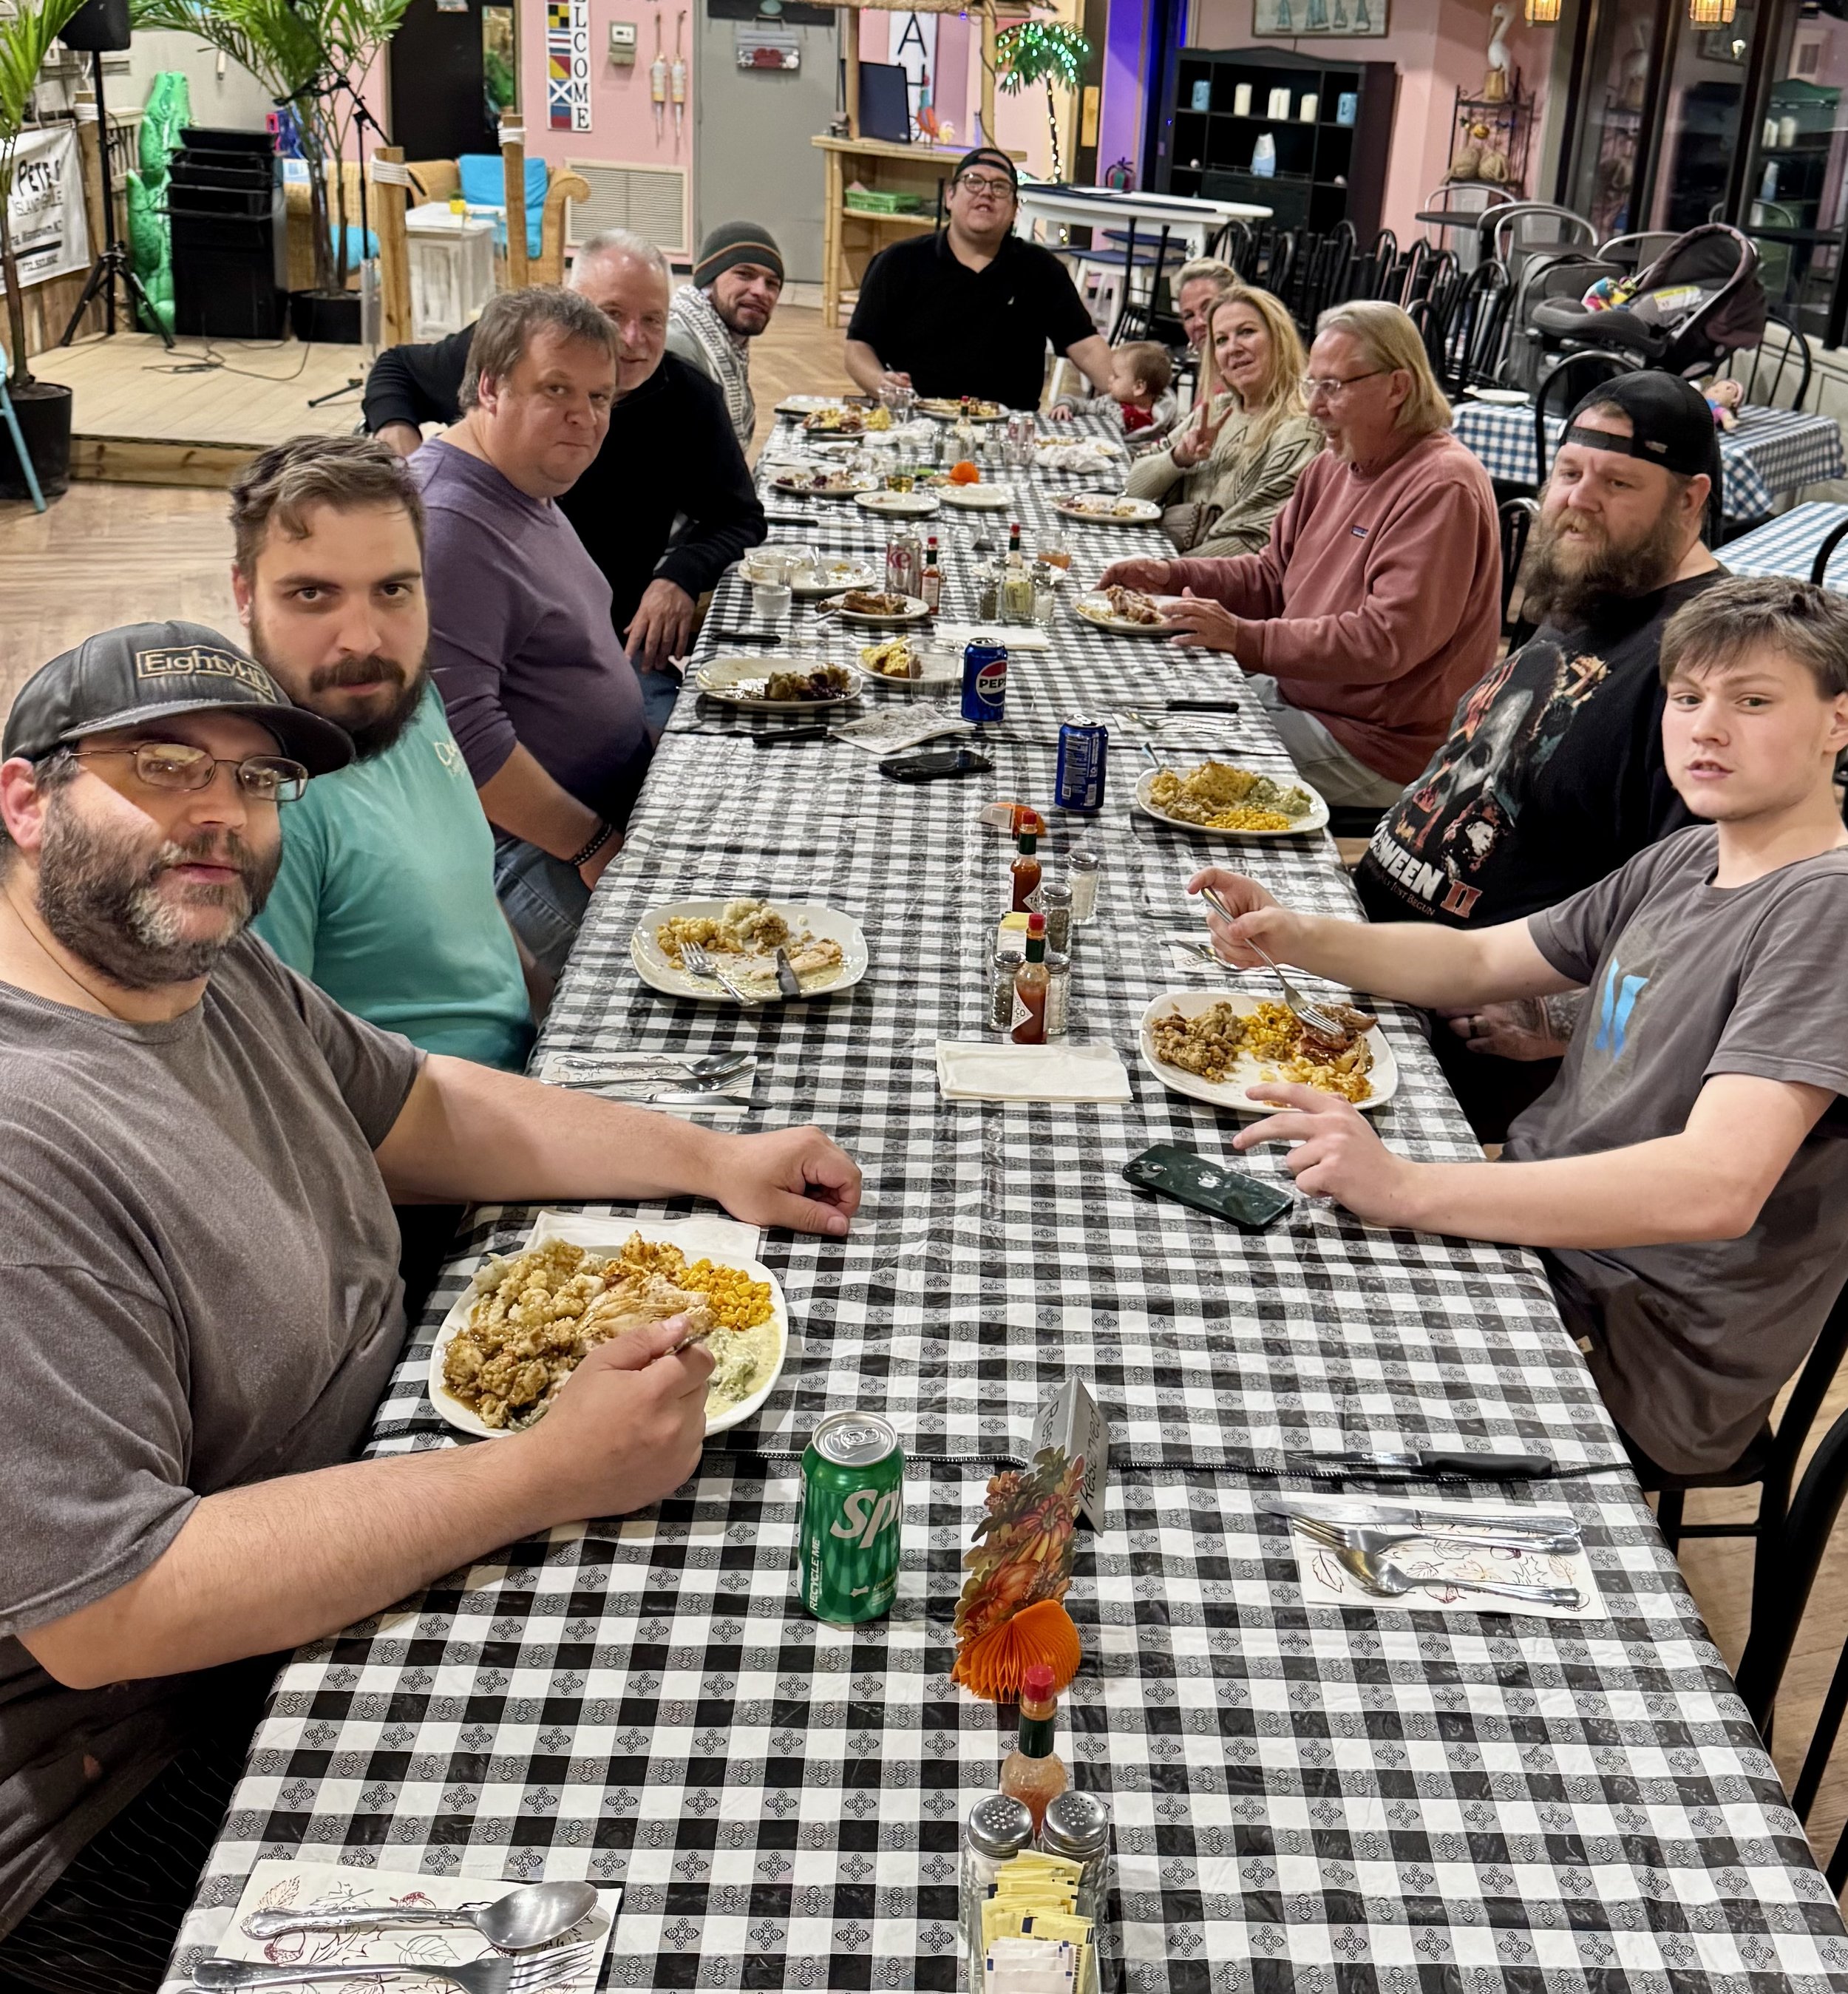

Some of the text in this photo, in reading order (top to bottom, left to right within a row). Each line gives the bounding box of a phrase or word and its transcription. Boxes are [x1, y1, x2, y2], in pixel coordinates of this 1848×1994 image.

[574, 0, 589, 129] LCOME
[1407, 893, 1436, 916] BEGUN
[1041, 1400, 1059, 1449] Res
[1080, 1403, 1101, 1510] Reserved
[829, 1489, 901, 1549] Sp
[812, 1537, 821, 1558] ME
[809, 1560, 820, 1611] RECYCLE
